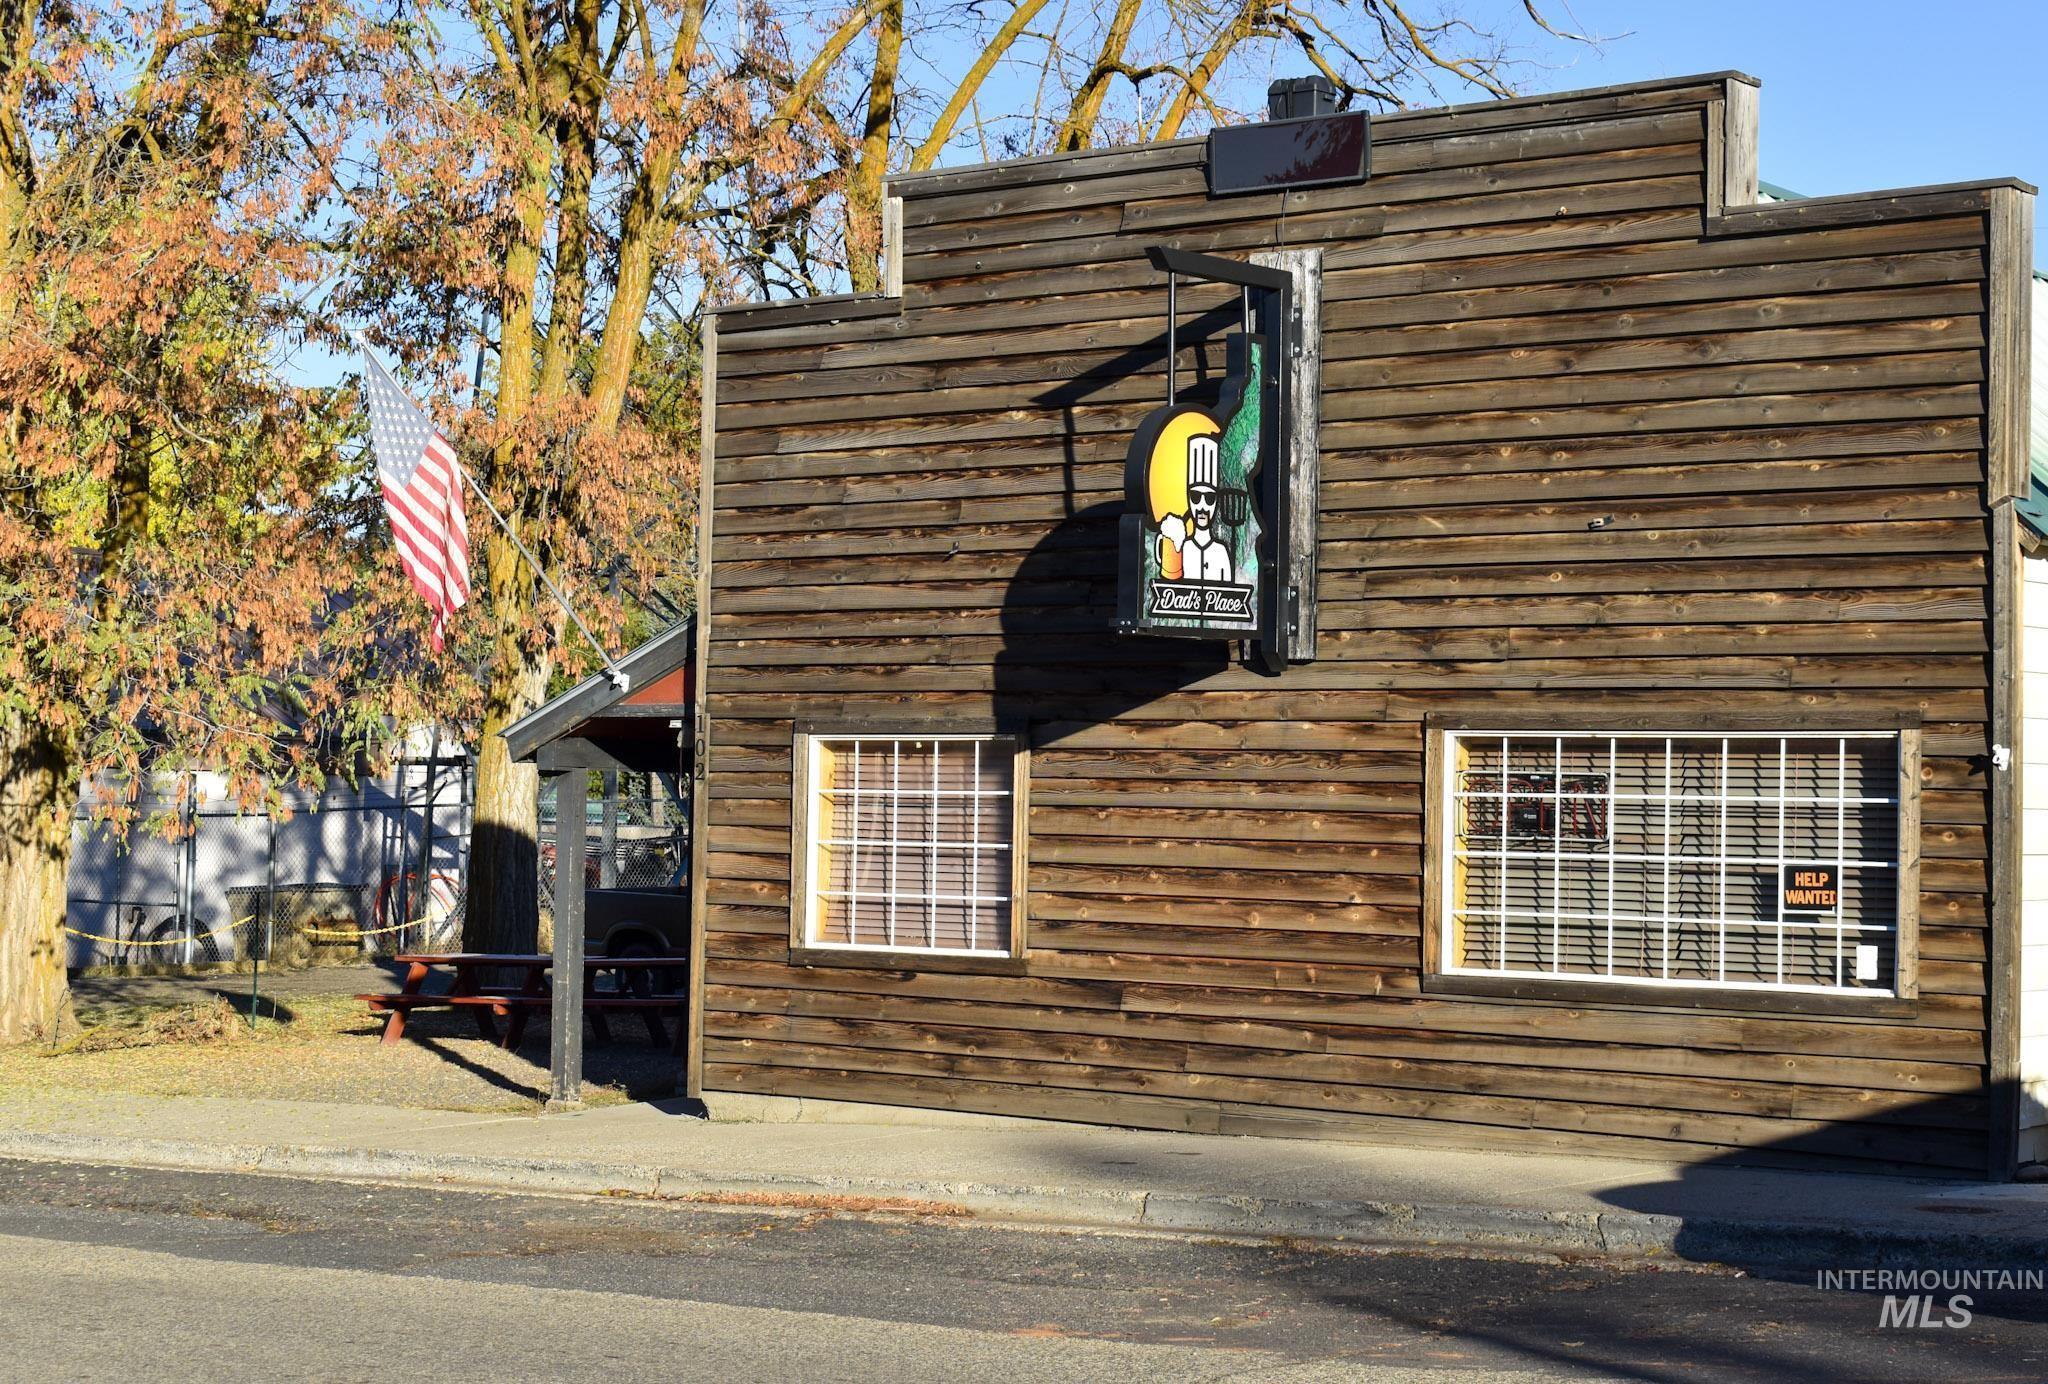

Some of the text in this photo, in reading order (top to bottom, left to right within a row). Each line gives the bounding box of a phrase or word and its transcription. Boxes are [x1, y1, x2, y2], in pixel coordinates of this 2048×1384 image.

[1160, 588, 1243, 612] Dad's Place
[695, 714, 705, 781] 102
[1794, 872, 1829, 887] HELP
[1785, 889, 1837, 905] WANTED
